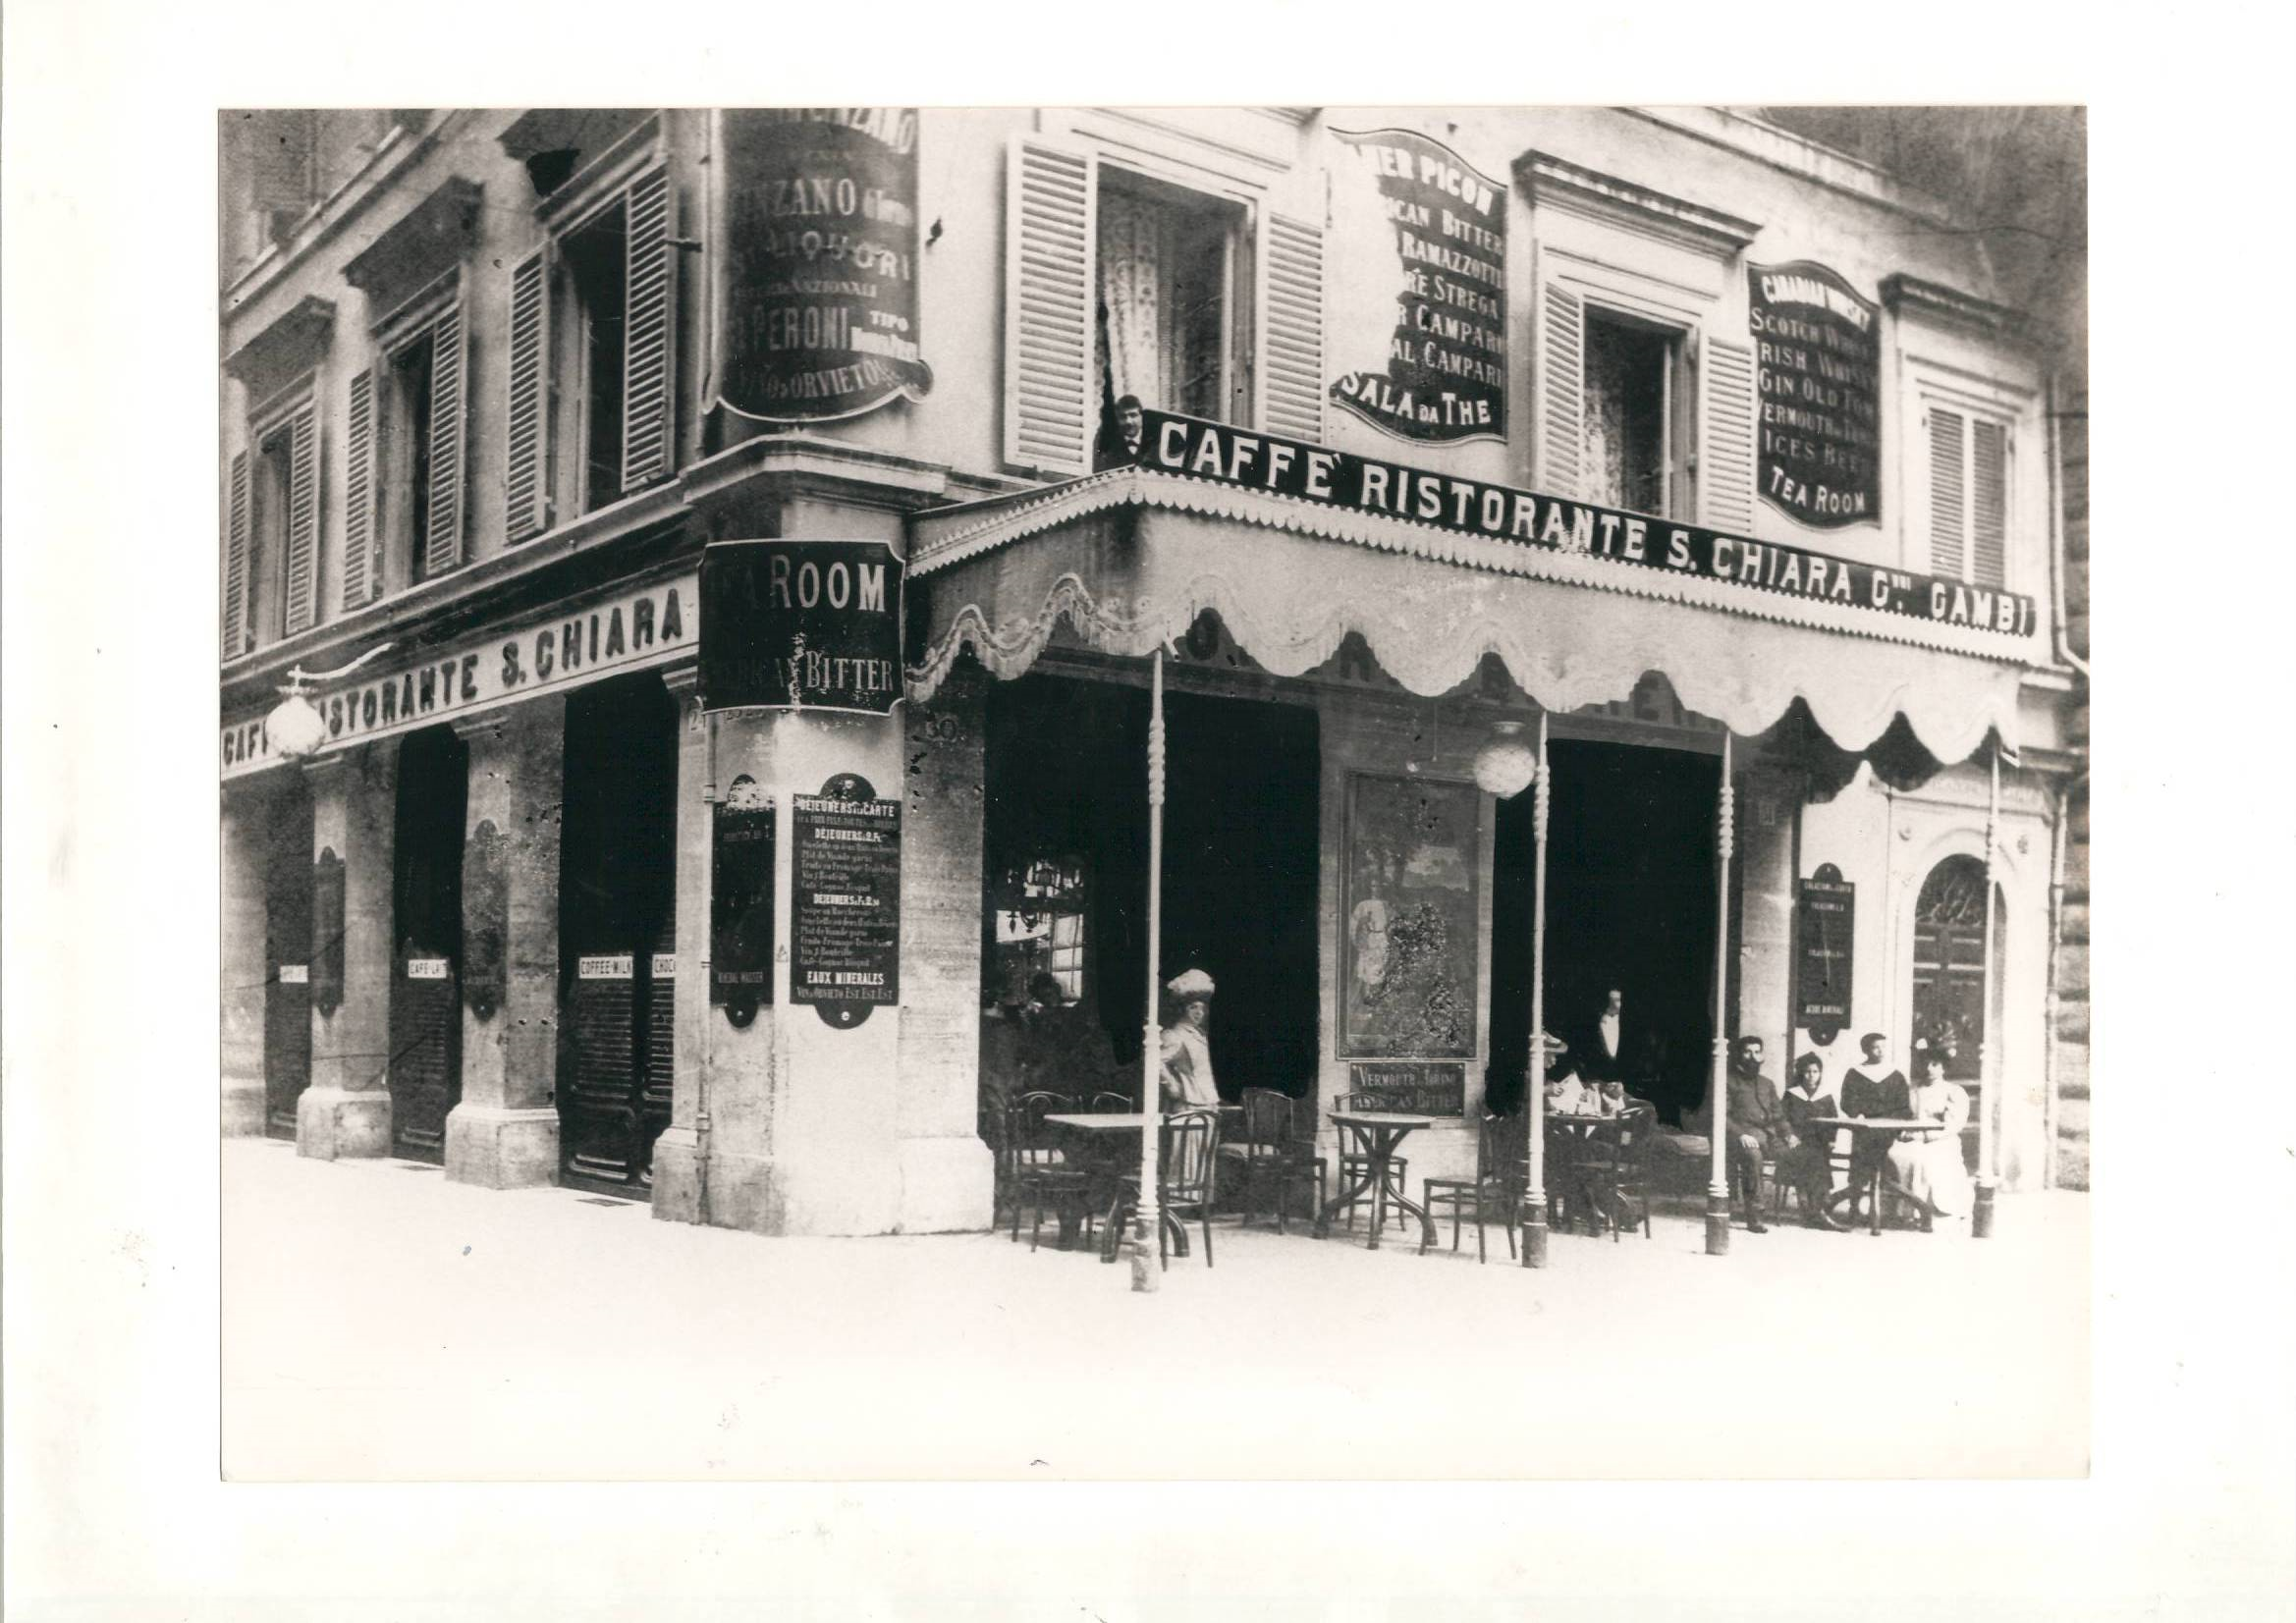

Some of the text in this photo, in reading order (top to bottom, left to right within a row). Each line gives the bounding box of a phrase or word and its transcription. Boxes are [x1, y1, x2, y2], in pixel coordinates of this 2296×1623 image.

[1421, 155, 1493, 215] PICON
[1443, 208, 1503, 256] BITTER
[1435, 275, 1500, 320] STREGA
[1416, 303, 1503, 354] CAMPARI
[1425, 341, 1503, 388] CAMPARI
[1759, 367, 1794, 396] GIN
[1803, 377, 1838, 407] OLD
[1340, 370, 1414, 422] SALA
[1442, 392, 1492, 425] THE
[1766, 429, 1816, 460] ICES
[1771, 464, 1865, 514] TEA ROOM
[1361, 463, 1647, 560] RISTORANTE
[1712, 537, 1852, 601] CHIARA
[1930, 581, 2031, 636] GAMBI
[770, 555, 886, 613] ROOM
[319, 653, 479, 738] ISTORANTE
[535, 588, 683, 681] CHIARA
[805, 651, 894, 691] BITTER
[806, 970, 832, 984] EAUX
